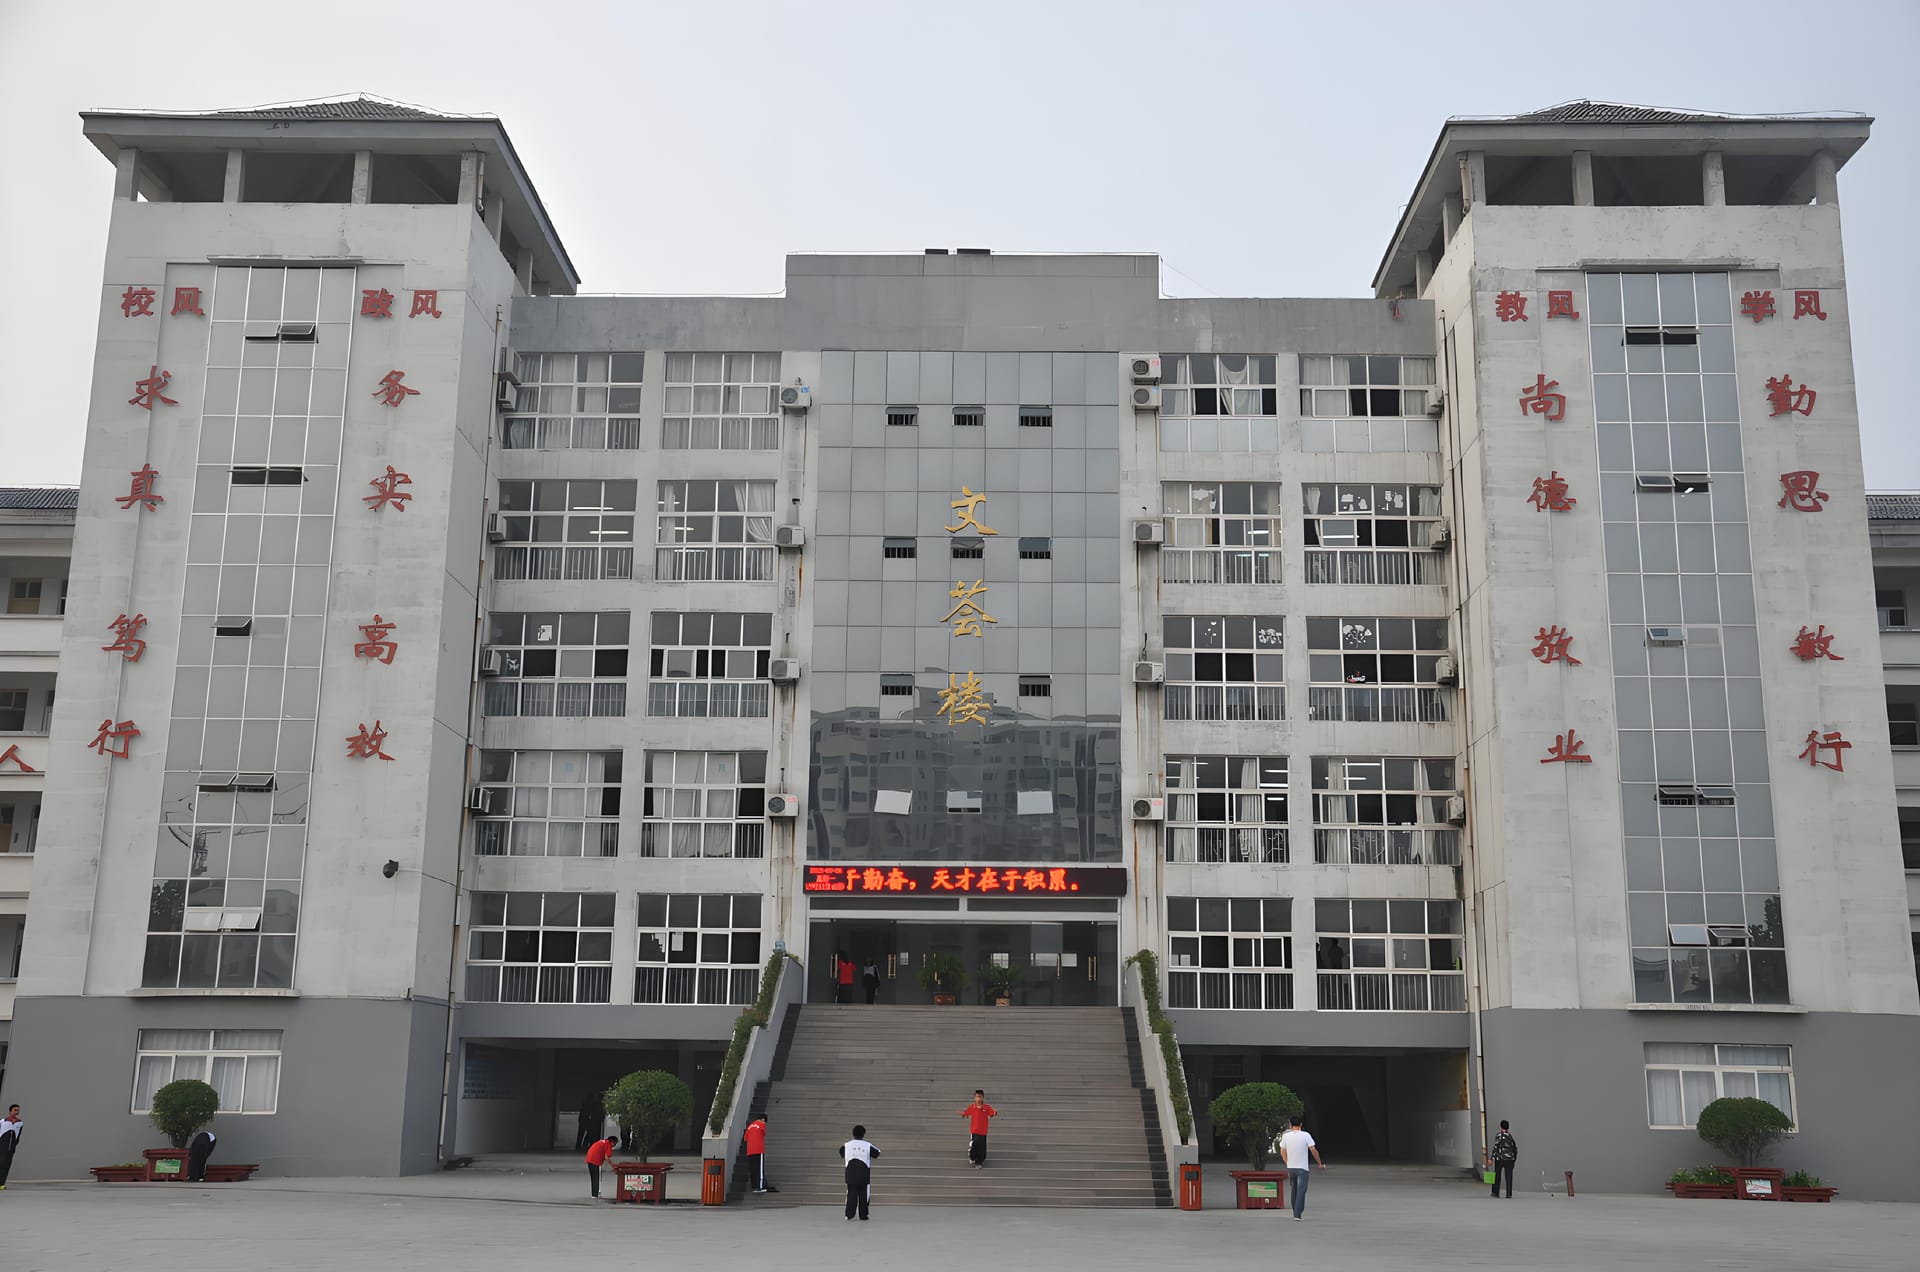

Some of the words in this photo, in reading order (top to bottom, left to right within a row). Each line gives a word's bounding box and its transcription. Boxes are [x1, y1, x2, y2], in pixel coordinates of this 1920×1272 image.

[121, 286, 204, 318] 校风
[361, 288, 441, 319] 政风
[1495, 290, 1580, 322] 教风
[1741, 290, 1827, 322] 学风
[88, 366, 178, 760] 求真笃行
[346, 370, 420, 762] 务实高效
[936, 485, 998, 727] 文荟楼
[1519, 374, 1592, 764] 尚德敬业
[1766, 374, 1852, 773] 勤思敏行
